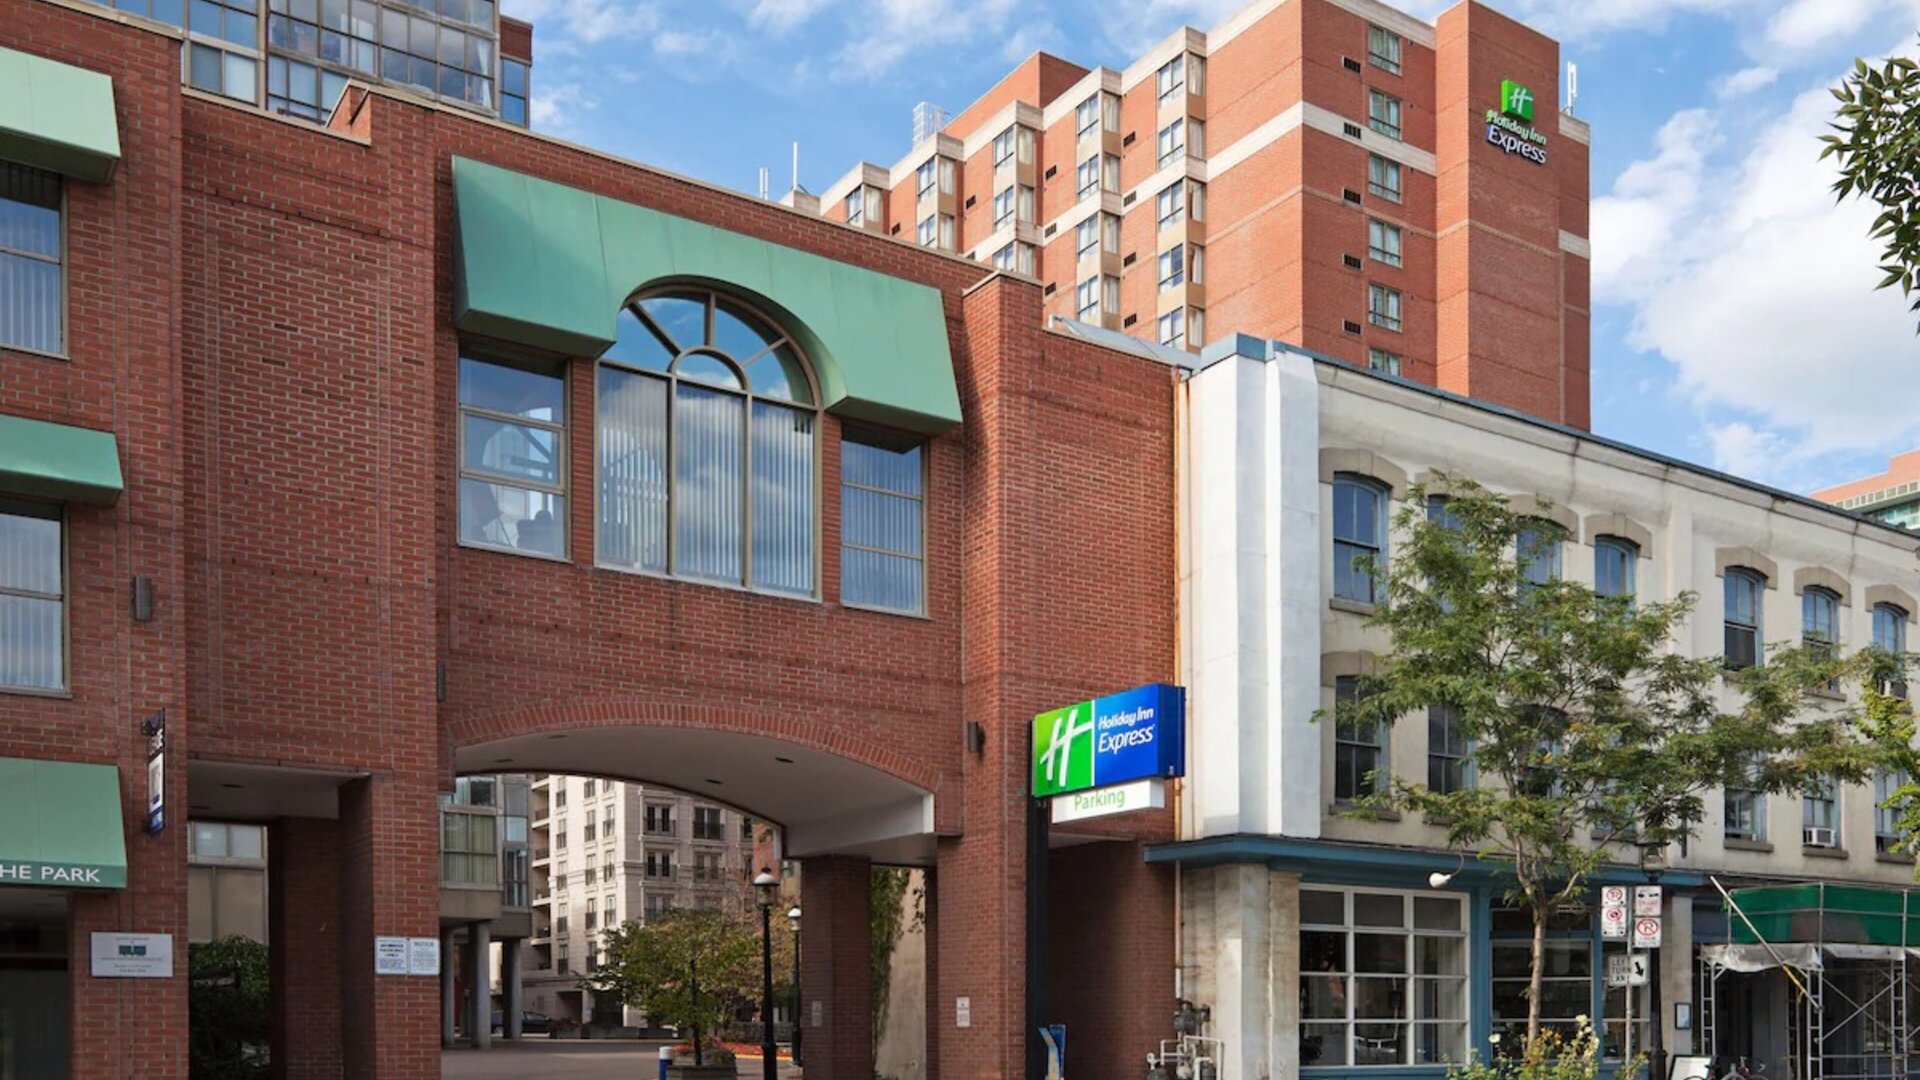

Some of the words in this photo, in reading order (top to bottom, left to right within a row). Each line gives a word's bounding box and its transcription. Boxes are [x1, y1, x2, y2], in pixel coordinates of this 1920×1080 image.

[1486, 109, 1529, 140] Holiday
[1529, 127, 1547, 145] Inn
[1487, 124, 1547, 164] Express
[1098, 711, 1136, 731] Holiday
[1136, 706, 1154, 722] Inn
[1098, 725, 1154, 755] Express
[1074, 789, 1126, 811] Parking
[41, 866, 101, 883] PARK
[1612, 958, 1630, 966] LEF
